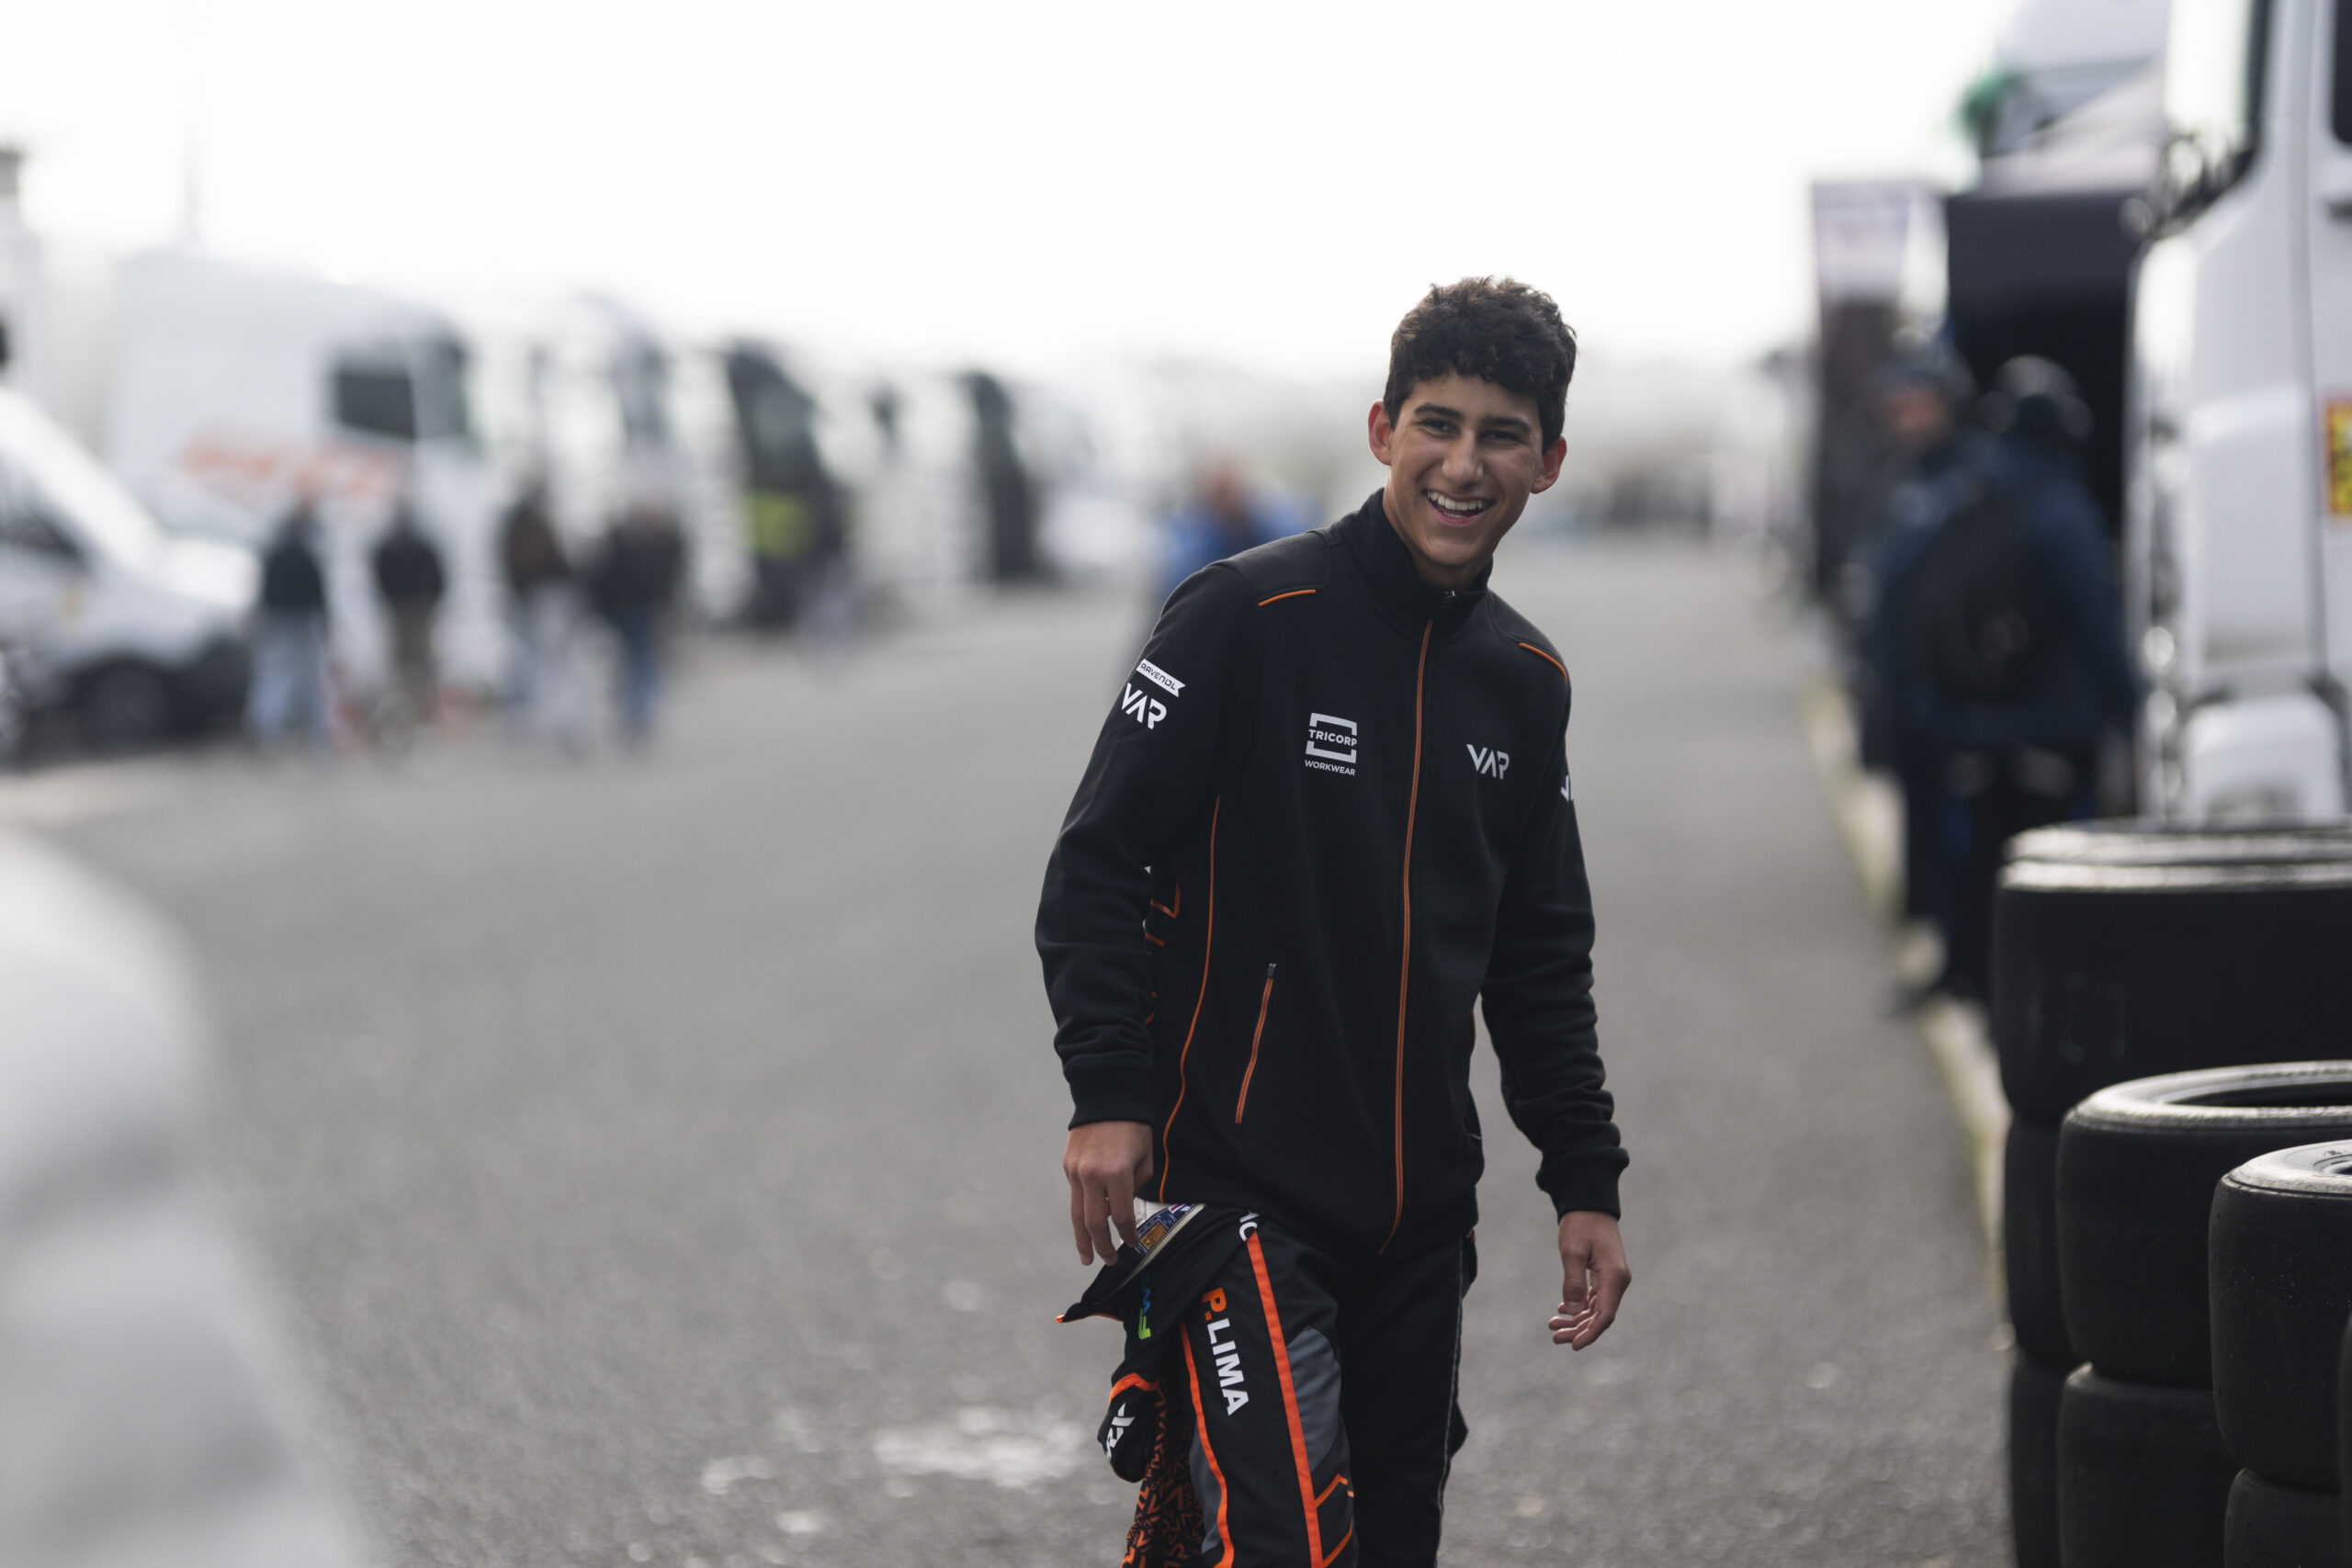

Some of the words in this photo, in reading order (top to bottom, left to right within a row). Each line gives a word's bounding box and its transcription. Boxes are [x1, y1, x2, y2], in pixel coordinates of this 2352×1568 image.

[1139, 662, 1176, 691] RAVENOL
[1121, 682, 1167, 729] VAR
[1308, 728, 1357, 747] TRICORP
[1305, 760, 1356, 776] WORKWEAR
[1466, 744, 1510, 780] VAR
[1201, 1287, 1250, 1416] P.LIMA
